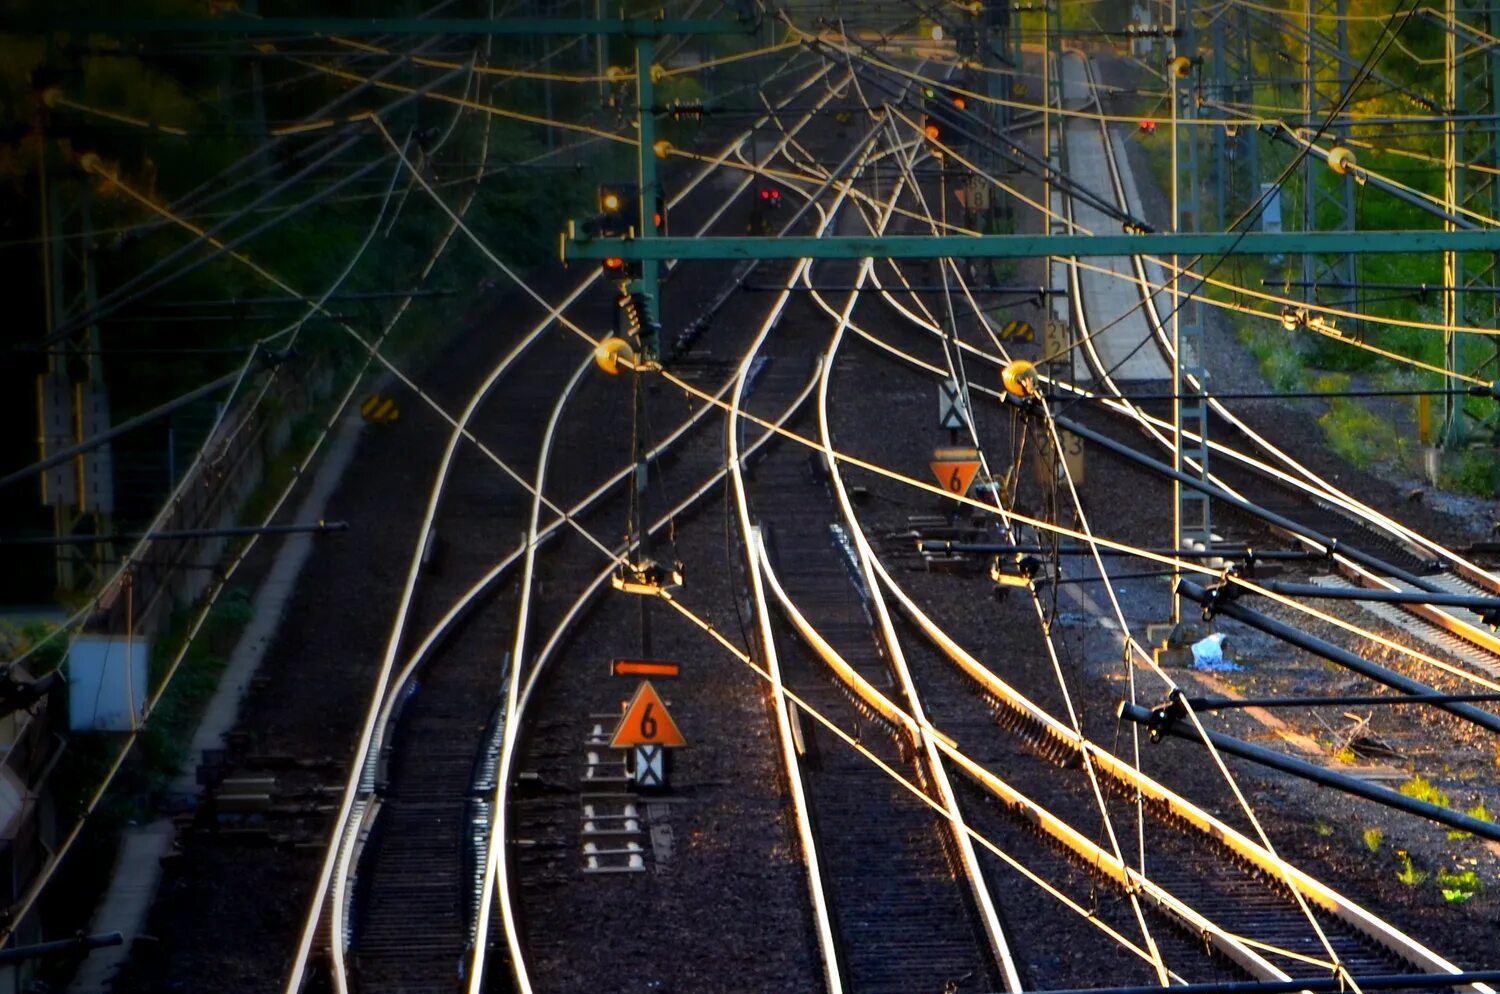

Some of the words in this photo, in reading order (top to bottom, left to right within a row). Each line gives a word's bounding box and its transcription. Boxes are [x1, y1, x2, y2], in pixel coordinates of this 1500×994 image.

[974, 191, 983, 207] 8
[1047, 321, 1065, 339] 21
[950, 467, 962, 492] 6
[640, 702, 658, 740] 6
